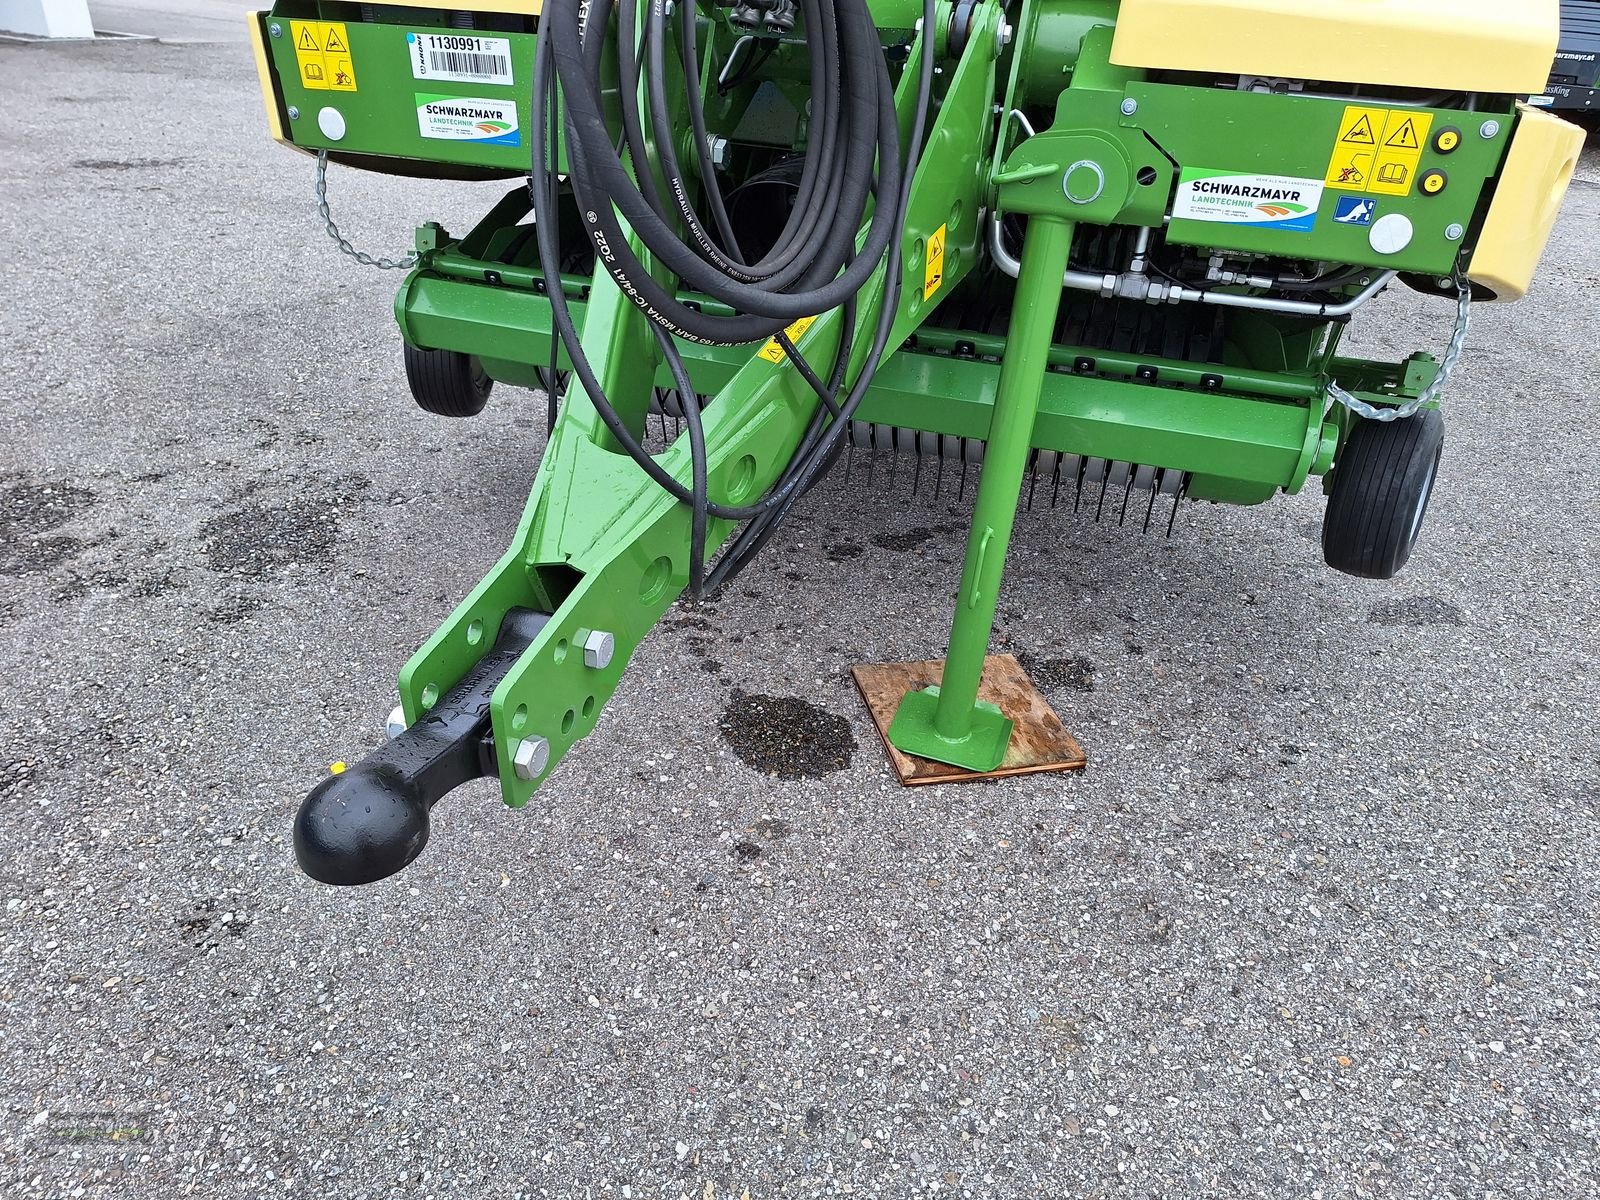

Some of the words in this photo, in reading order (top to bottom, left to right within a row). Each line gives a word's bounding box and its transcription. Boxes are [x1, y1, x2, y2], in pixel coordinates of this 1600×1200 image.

[429, 36, 481, 51] 1130991
[426, 105, 503, 120] SCHWARZMAYR
[429, 117, 474, 127] LANDTECHNIK
[1192, 181, 1301, 201] SCHWARZMAYR
[1192, 195, 1254, 208] LANDTECHNIK
[672, 178, 694, 223] HYDRAULIK
[690, 222, 712, 253] MUELLER
[709, 250, 728, 270] RHEINE
[593, 230, 616, 263] 2Q22
[613, 268, 649, 308] IC-84/41
[647, 306, 677, 331] MSHA
[675, 329, 699, 342] BAR
